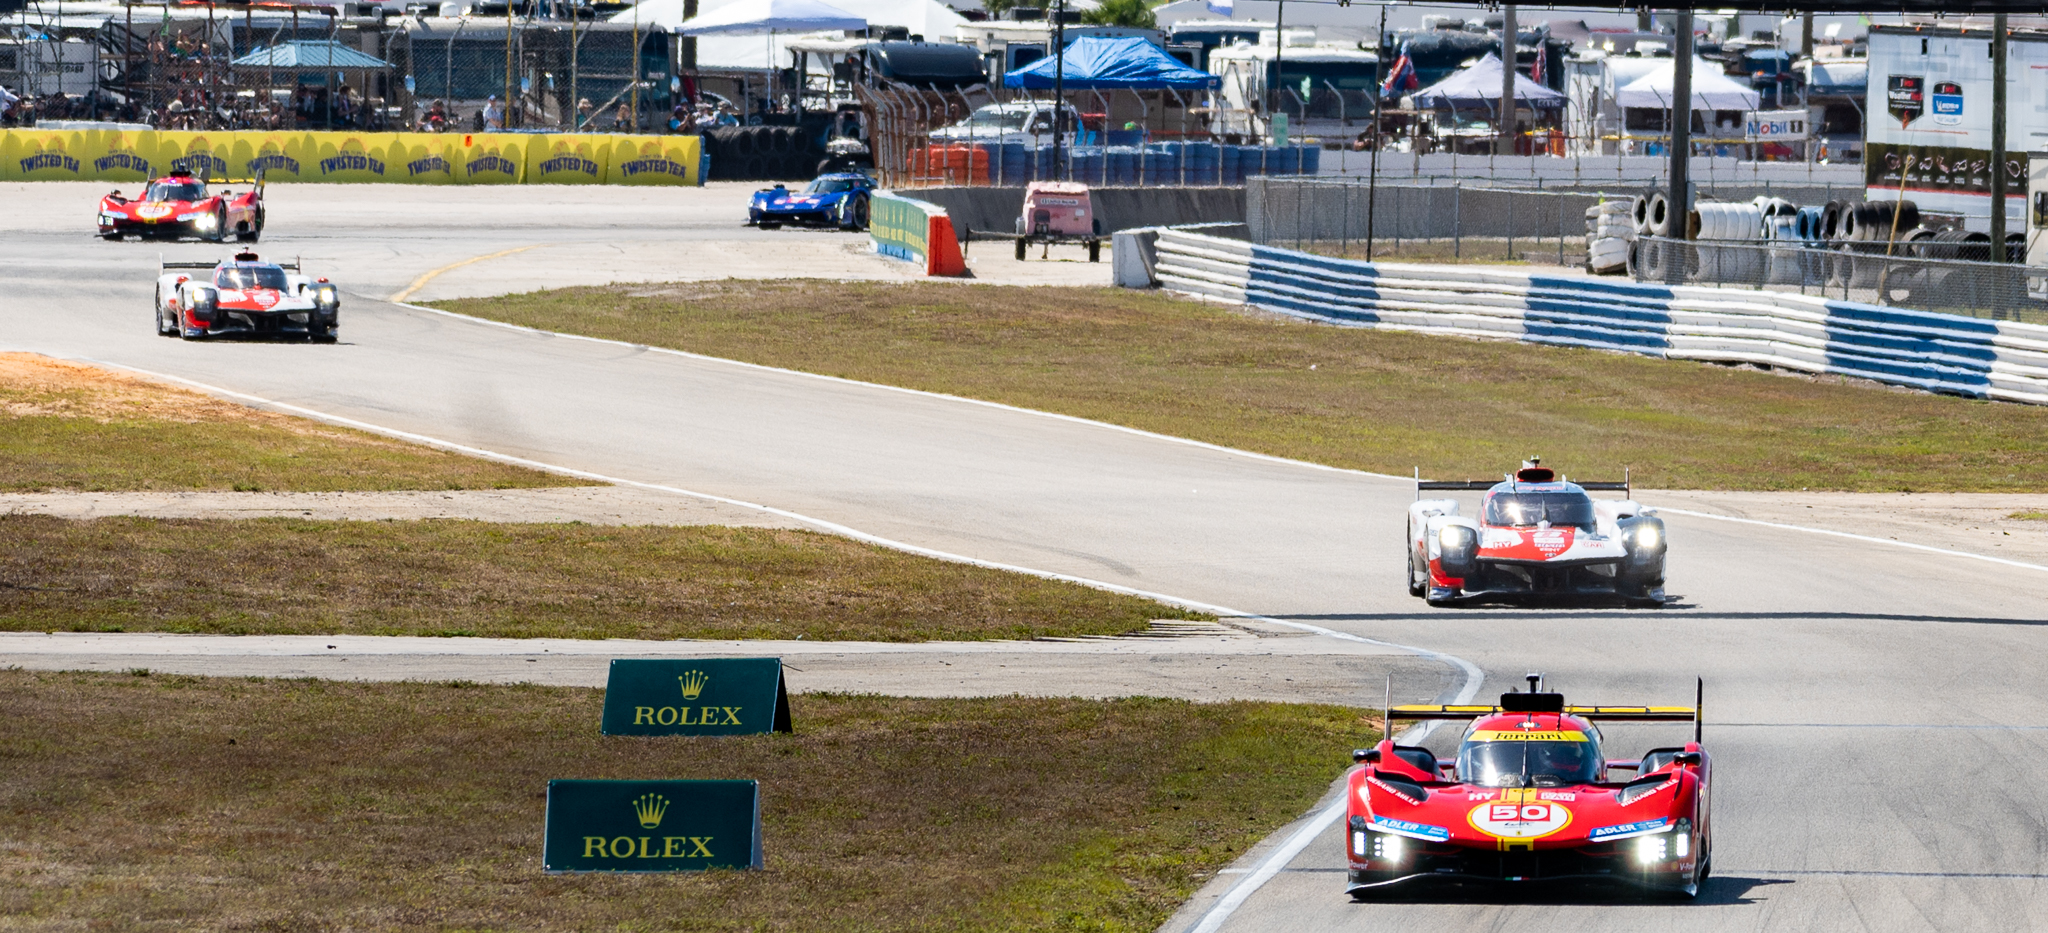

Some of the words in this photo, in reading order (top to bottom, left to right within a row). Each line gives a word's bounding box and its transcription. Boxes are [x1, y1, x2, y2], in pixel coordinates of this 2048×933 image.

[1747, 120, 1788, 135] Mobil
[20, 153, 62, 174] TWISTED
[63, 155, 80, 174] TEA
[94, 153, 131, 174] TWISTED
[131, 155, 149, 174] TEA
[212, 156, 227, 175] TEA
[285, 156, 300, 176] TEA
[319, 155, 367, 175] TWISTED
[367, 157, 386, 176] TEA
[407, 157, 442, 176] TWISTED
[466, 156, 499, 177] TWISTED
[498, 157, 515, 177] TEA
[539, 157, 581, 176] TWISTED
[580, 158, 598, 178] TEA
[620, 159, 668, 177] TWISTED
[667, 160, 687, 179] TEA
[633, 706, 742, 725] ROLEX
[1394, 791, 1420, 806] MILLE
[1468, 792, 1495, 801] HY
[1620, 788, 1658, 807] RICHARD
[1656, 779, 1680, 792] MILLE
[1492, 805, 1549, 820] 50
[1377, 818, 1420, 831] ADLER
[1595, 824, 1637, 836] ADLER
[581, 837, 714, 858] ROLEX
